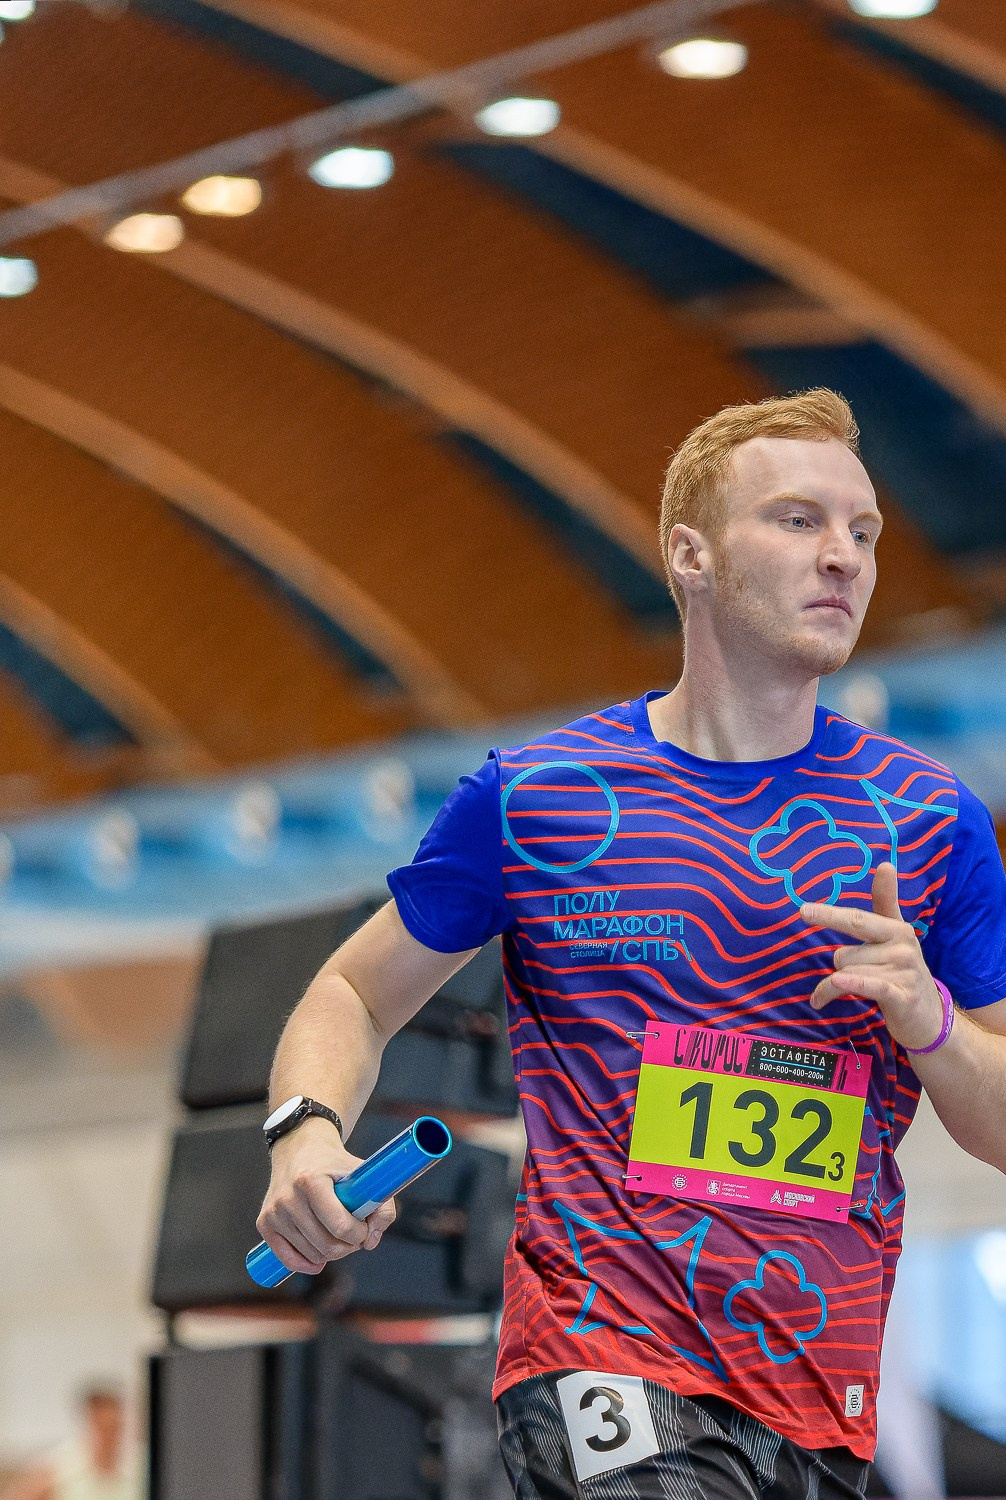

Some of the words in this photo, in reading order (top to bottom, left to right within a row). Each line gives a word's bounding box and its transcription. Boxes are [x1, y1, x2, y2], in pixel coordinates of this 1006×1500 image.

[553, 891, 620, 916] ПОЛУ
[553, 914, 684, 940] МАРАФОН
[760, 1046, 826, 1067] ЭСТАФЕТА
[679, 1081, 833, 1180] 132
[828, 1152, 846, 1182] 3
[579, 1386, 632, 1453] 3
